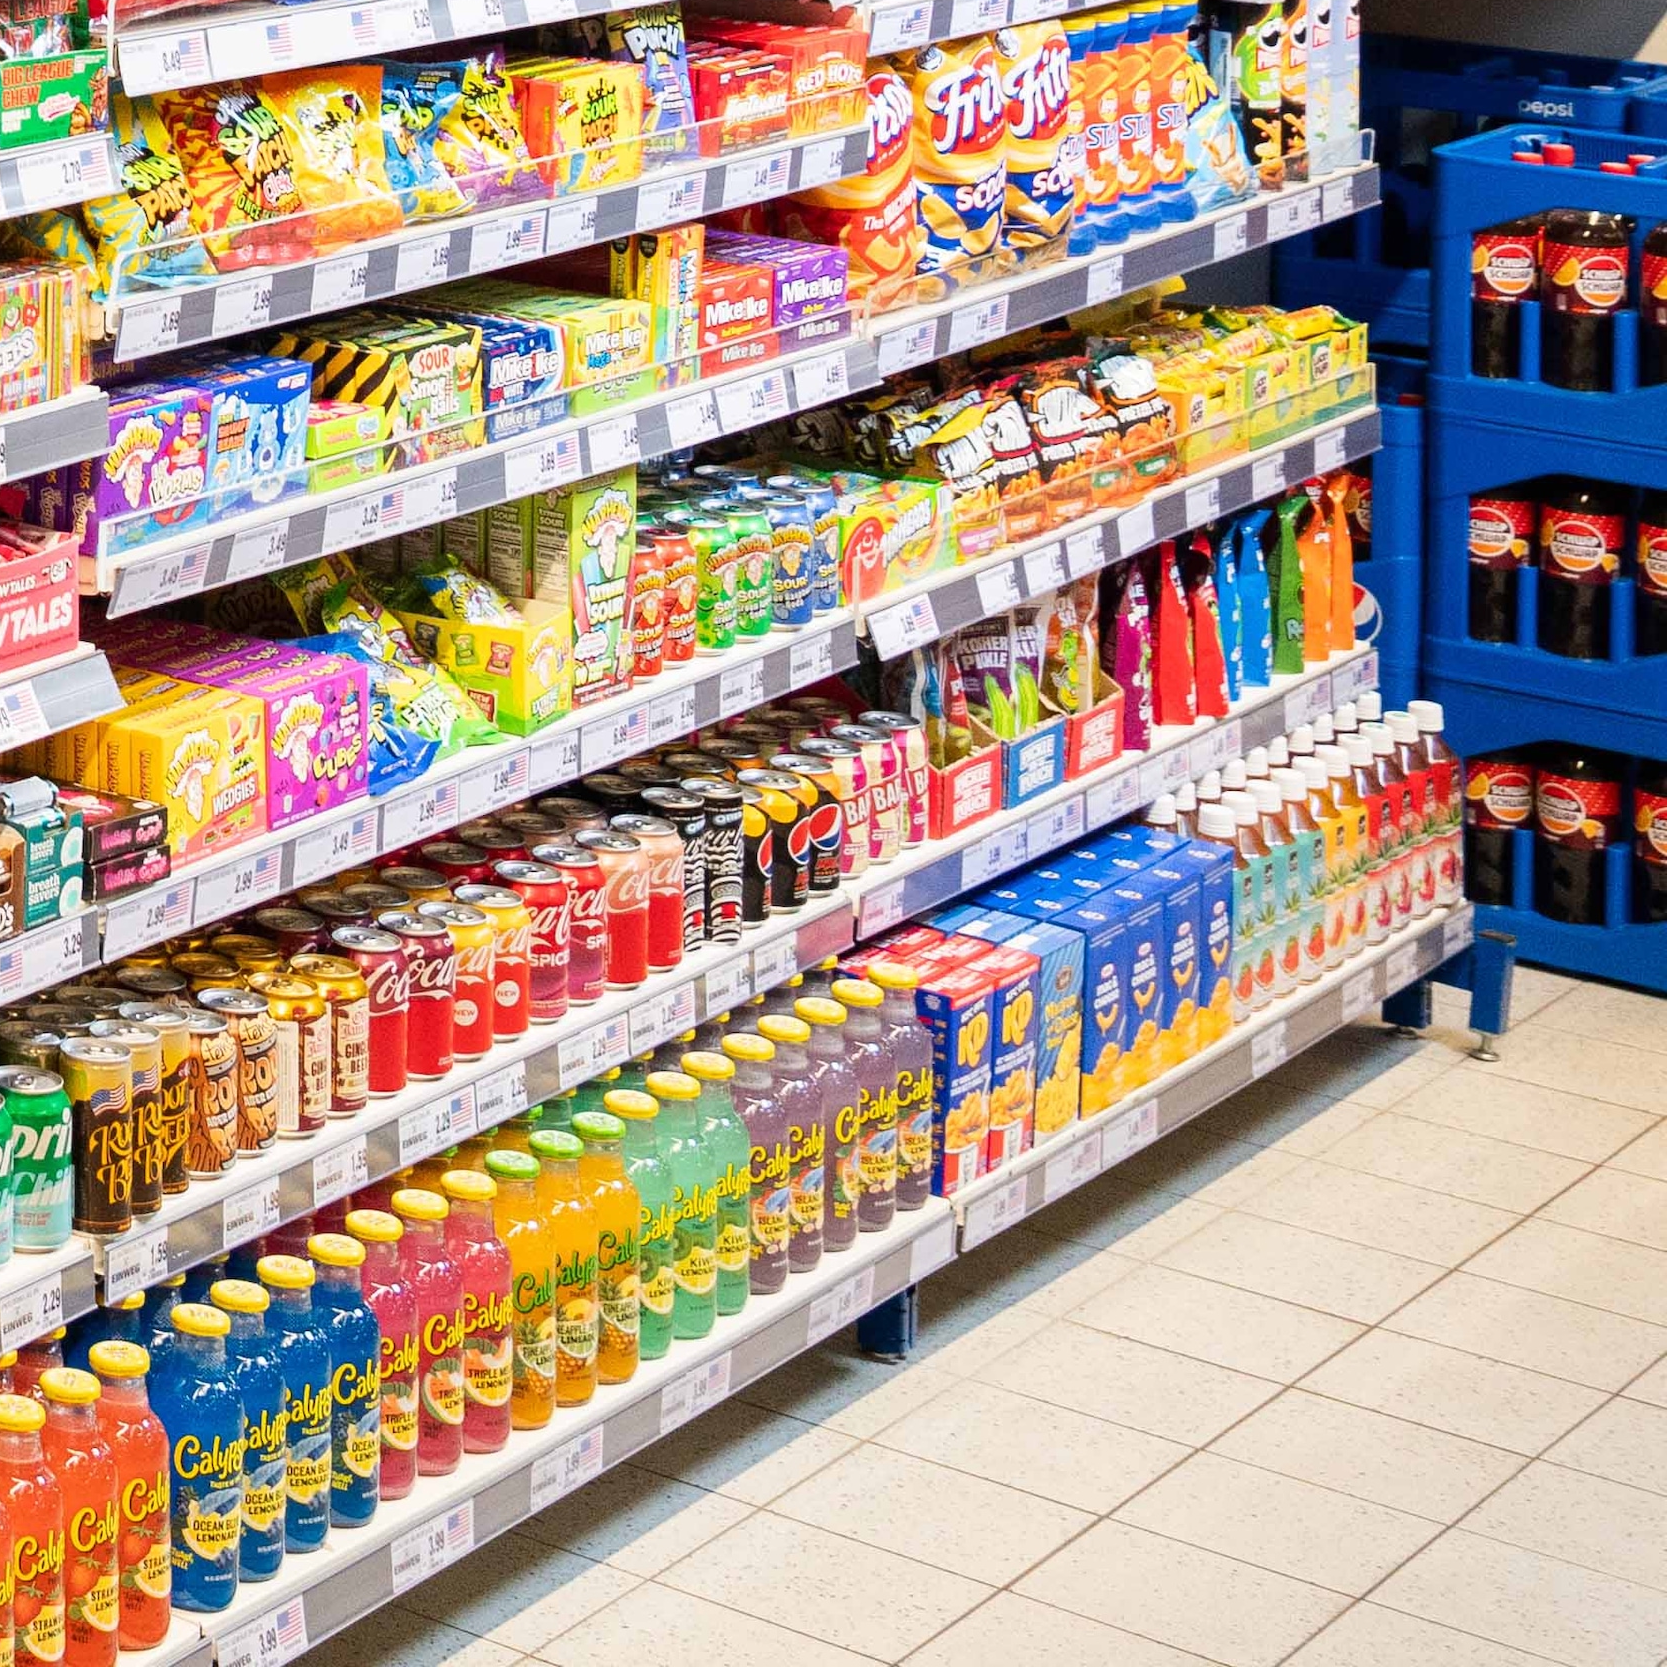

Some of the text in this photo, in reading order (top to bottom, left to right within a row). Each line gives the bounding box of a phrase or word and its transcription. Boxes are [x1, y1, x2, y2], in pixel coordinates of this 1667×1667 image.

[1, 58, 72, 86] BIG LEAGUE
[2, 85, 38, 106] CHEW
[1518, 99, 1574, 120] pepsi
[419, 348, 450, 373] SOUR
[6, 597, 72, 646] TALES
[211, 775, 257, 815] WEDGIES
[63, 933, 83, 958] 3.29
[149, 1240, 168, 1263] 1.59
[111, 1261, 142, 1284] EINWEG
[43, 1292, 62, 1315] 2.29
[426, 1536, 446, 1565] 3.99
[259, 1628, 277, 1653] 3.99
